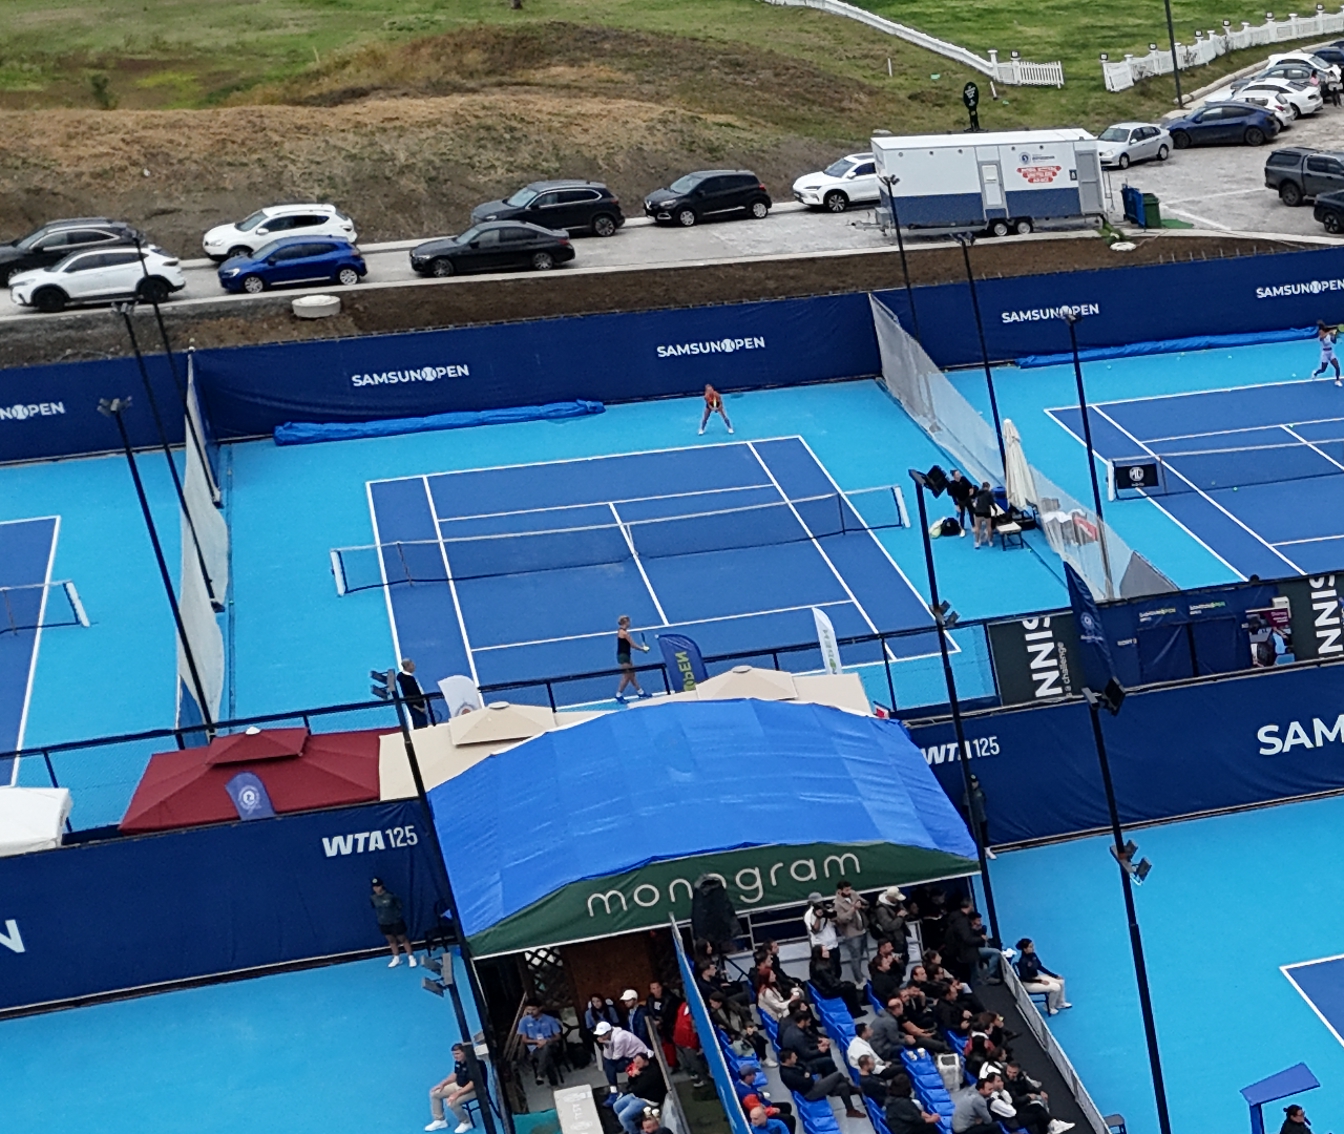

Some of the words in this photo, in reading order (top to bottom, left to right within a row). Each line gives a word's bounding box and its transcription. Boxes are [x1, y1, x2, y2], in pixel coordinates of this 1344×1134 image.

[974, 736, 1001, 758] 125
[322, 831, 386, 857] WTA
[385, 826, 418, 849] 125
